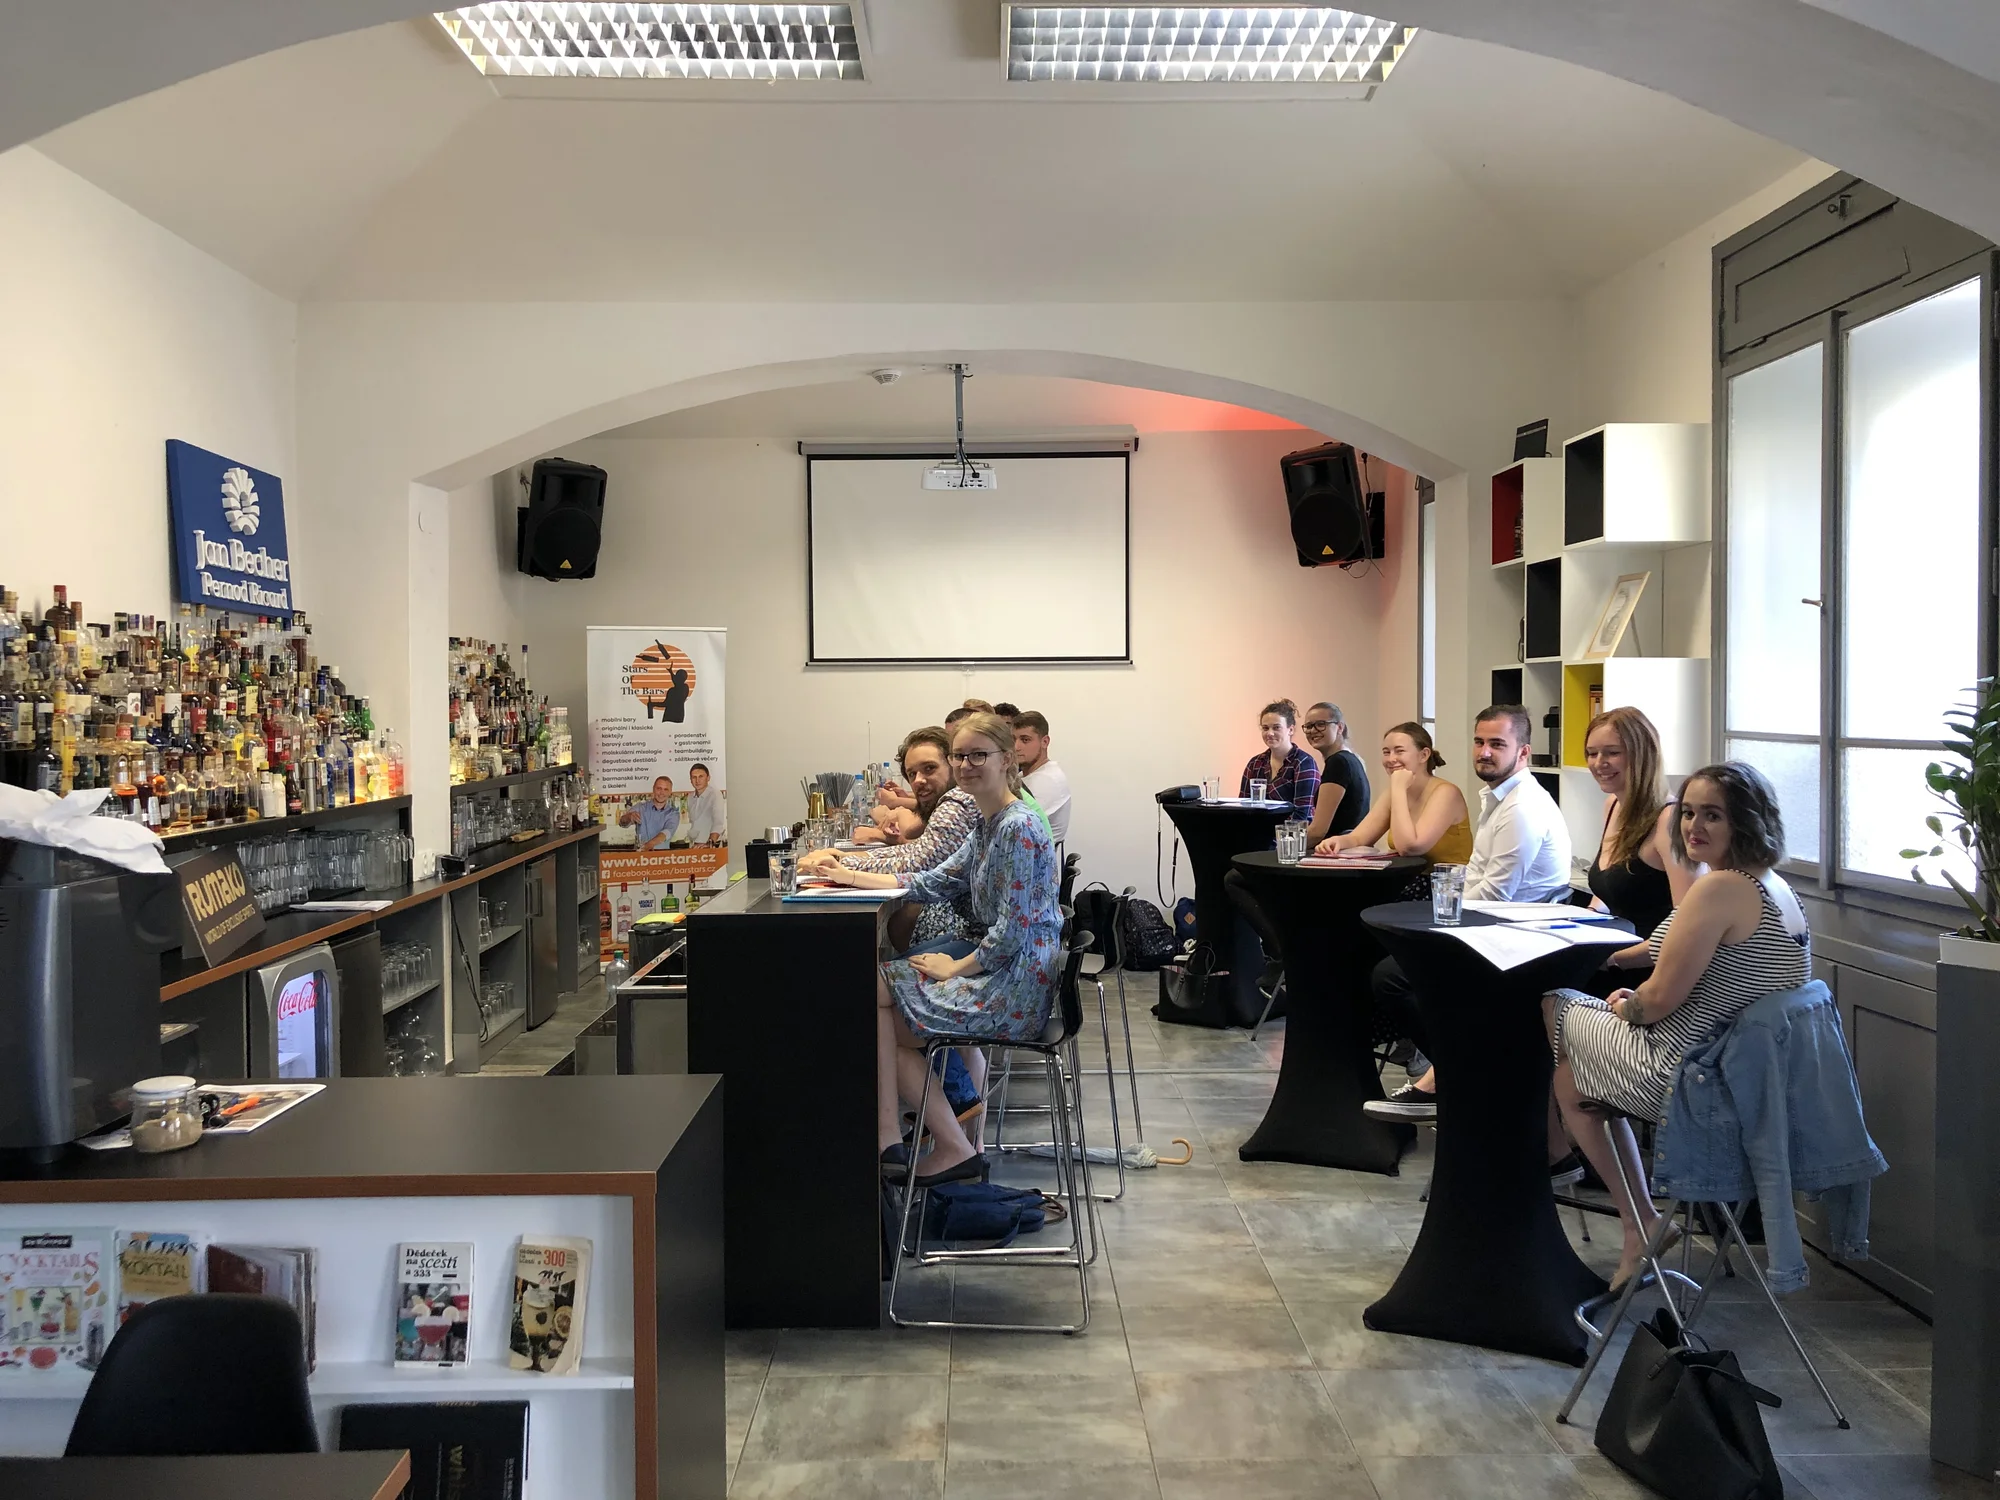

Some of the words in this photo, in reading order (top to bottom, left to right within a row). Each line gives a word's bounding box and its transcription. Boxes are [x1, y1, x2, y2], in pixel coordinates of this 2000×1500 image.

[193, 529, 231, 570] Jan
[228, 538, 289, 582] Becher
[200, 571, 248, 603] Pernod
[248, 581, 289, 609] Ricard
[622, 664, 648, 673] Stars
[621, 675, 634, 684] Of
[620, 687, 640, 695] The
[642, 687, 665, 695] Bars
[601, 853, 716, 868] www.barstars.cz
[613, 866, 716, 878] facebook.com/barstars.cz
[543, 1249, 566, 1267] 300
[413, 1269, 431, 1277] 333
